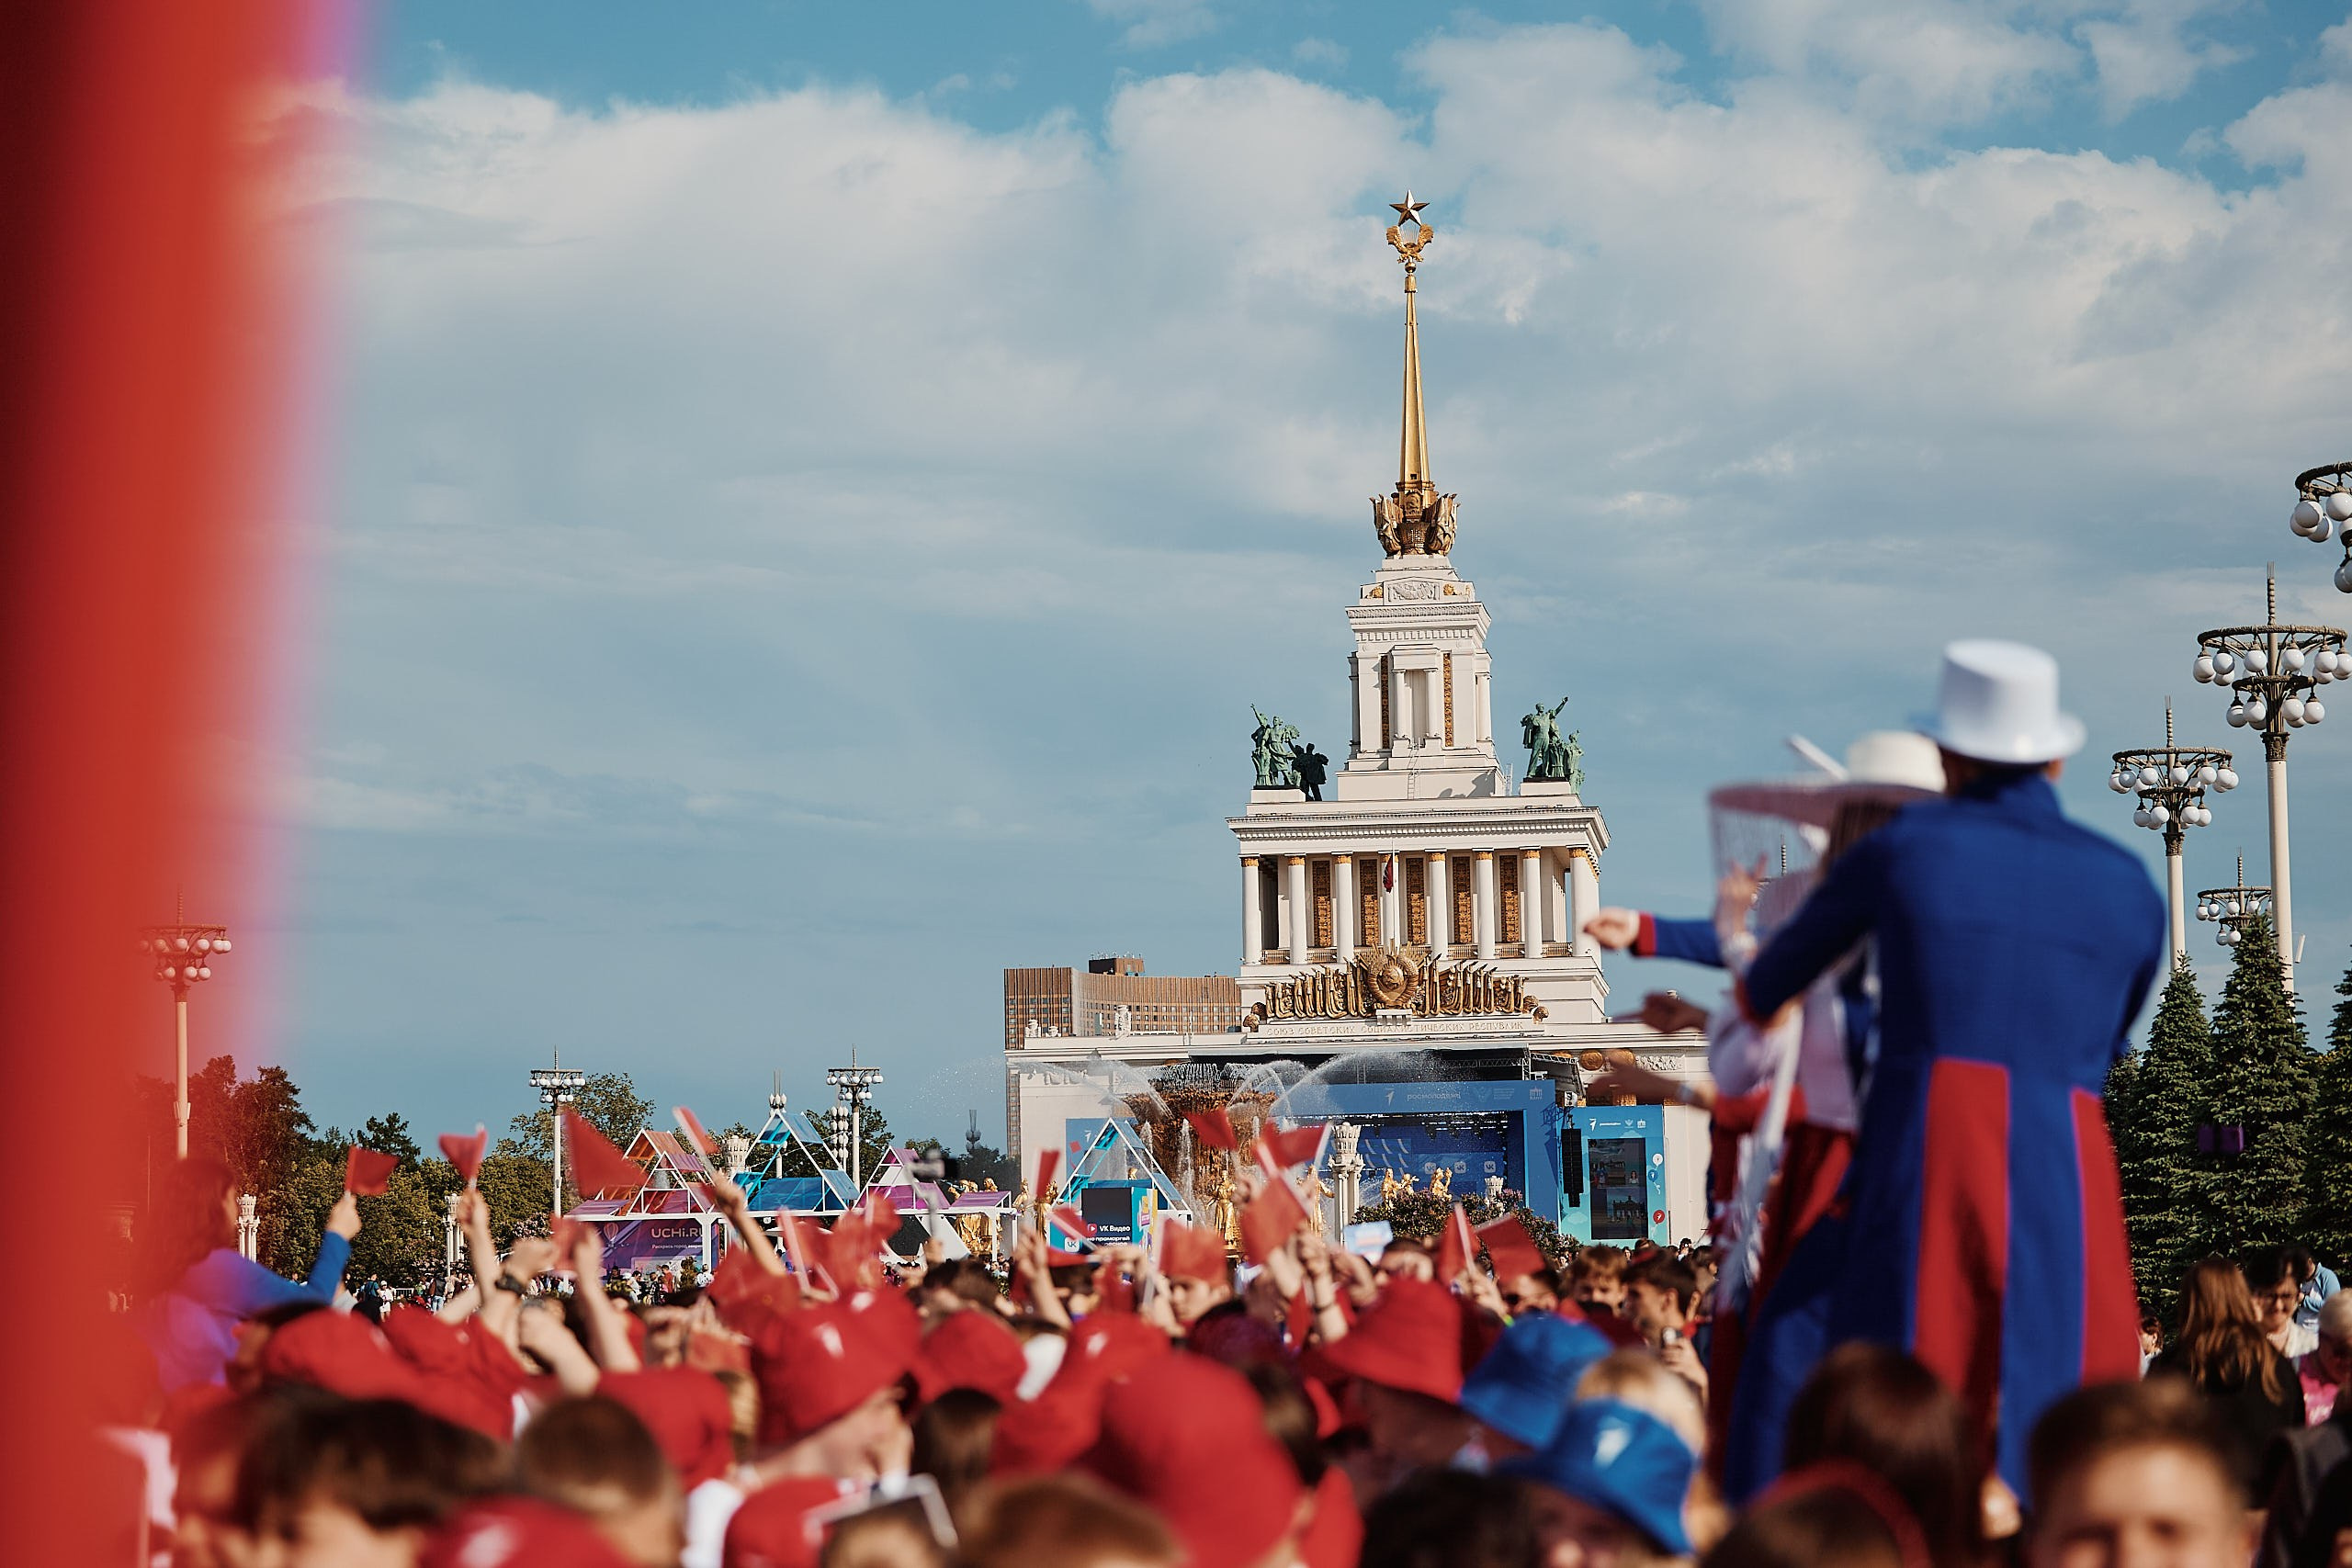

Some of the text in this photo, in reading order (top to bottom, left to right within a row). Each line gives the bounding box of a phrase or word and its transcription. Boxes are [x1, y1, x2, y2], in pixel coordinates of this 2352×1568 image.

[1267, 1021, 1523, 1036] СОЮЗ СОВЕТСКИХ СОЦИАЛИСТИЧЕСКИХ РЕСПУБЛИК
